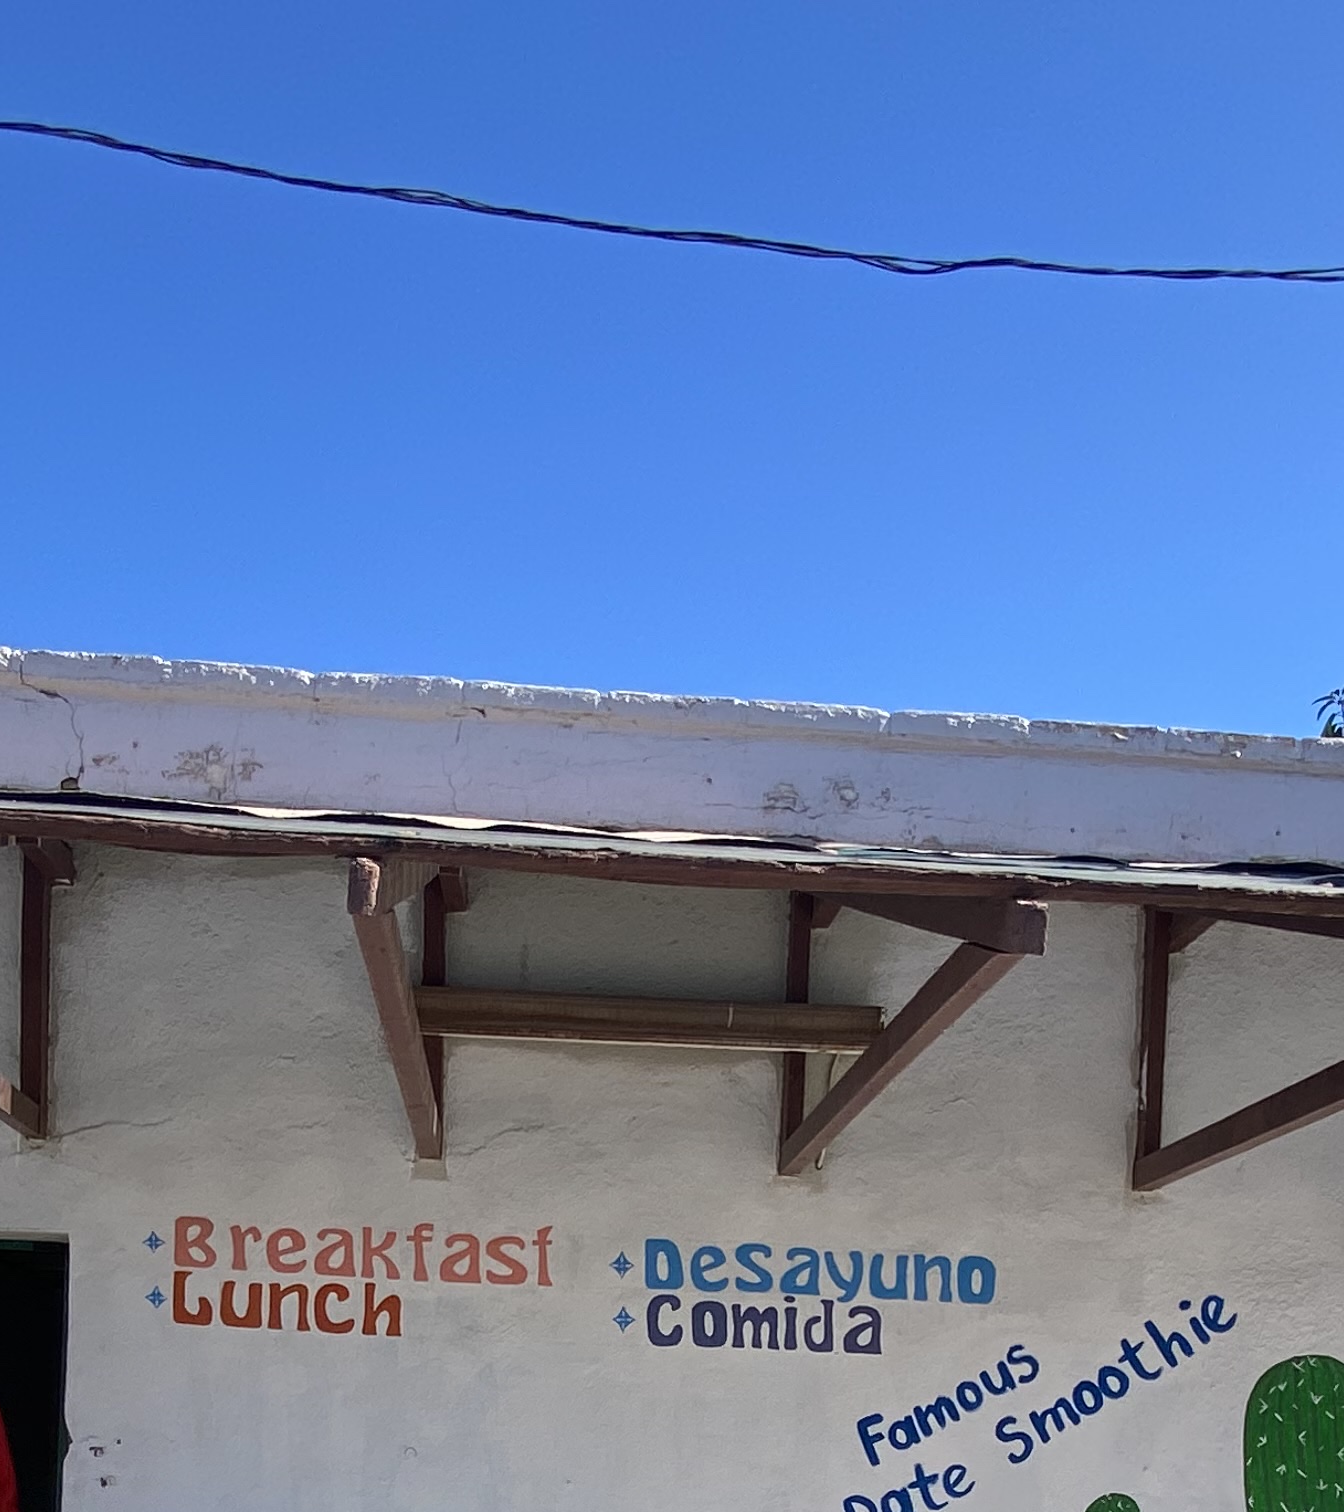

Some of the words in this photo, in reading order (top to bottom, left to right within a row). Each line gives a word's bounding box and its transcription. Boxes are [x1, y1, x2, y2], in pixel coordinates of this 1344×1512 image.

[173, 1216, 554, 1287] Breakfast
[644, 1238, 997, 1305] Desayuno
[172, 1271, 402, 1337] Lunch
[646, 1294, 883, 1355] Comida
[856, 1344, 1039, 1467] Famous
[995, 1294, 1237, 1464] Smoothie
